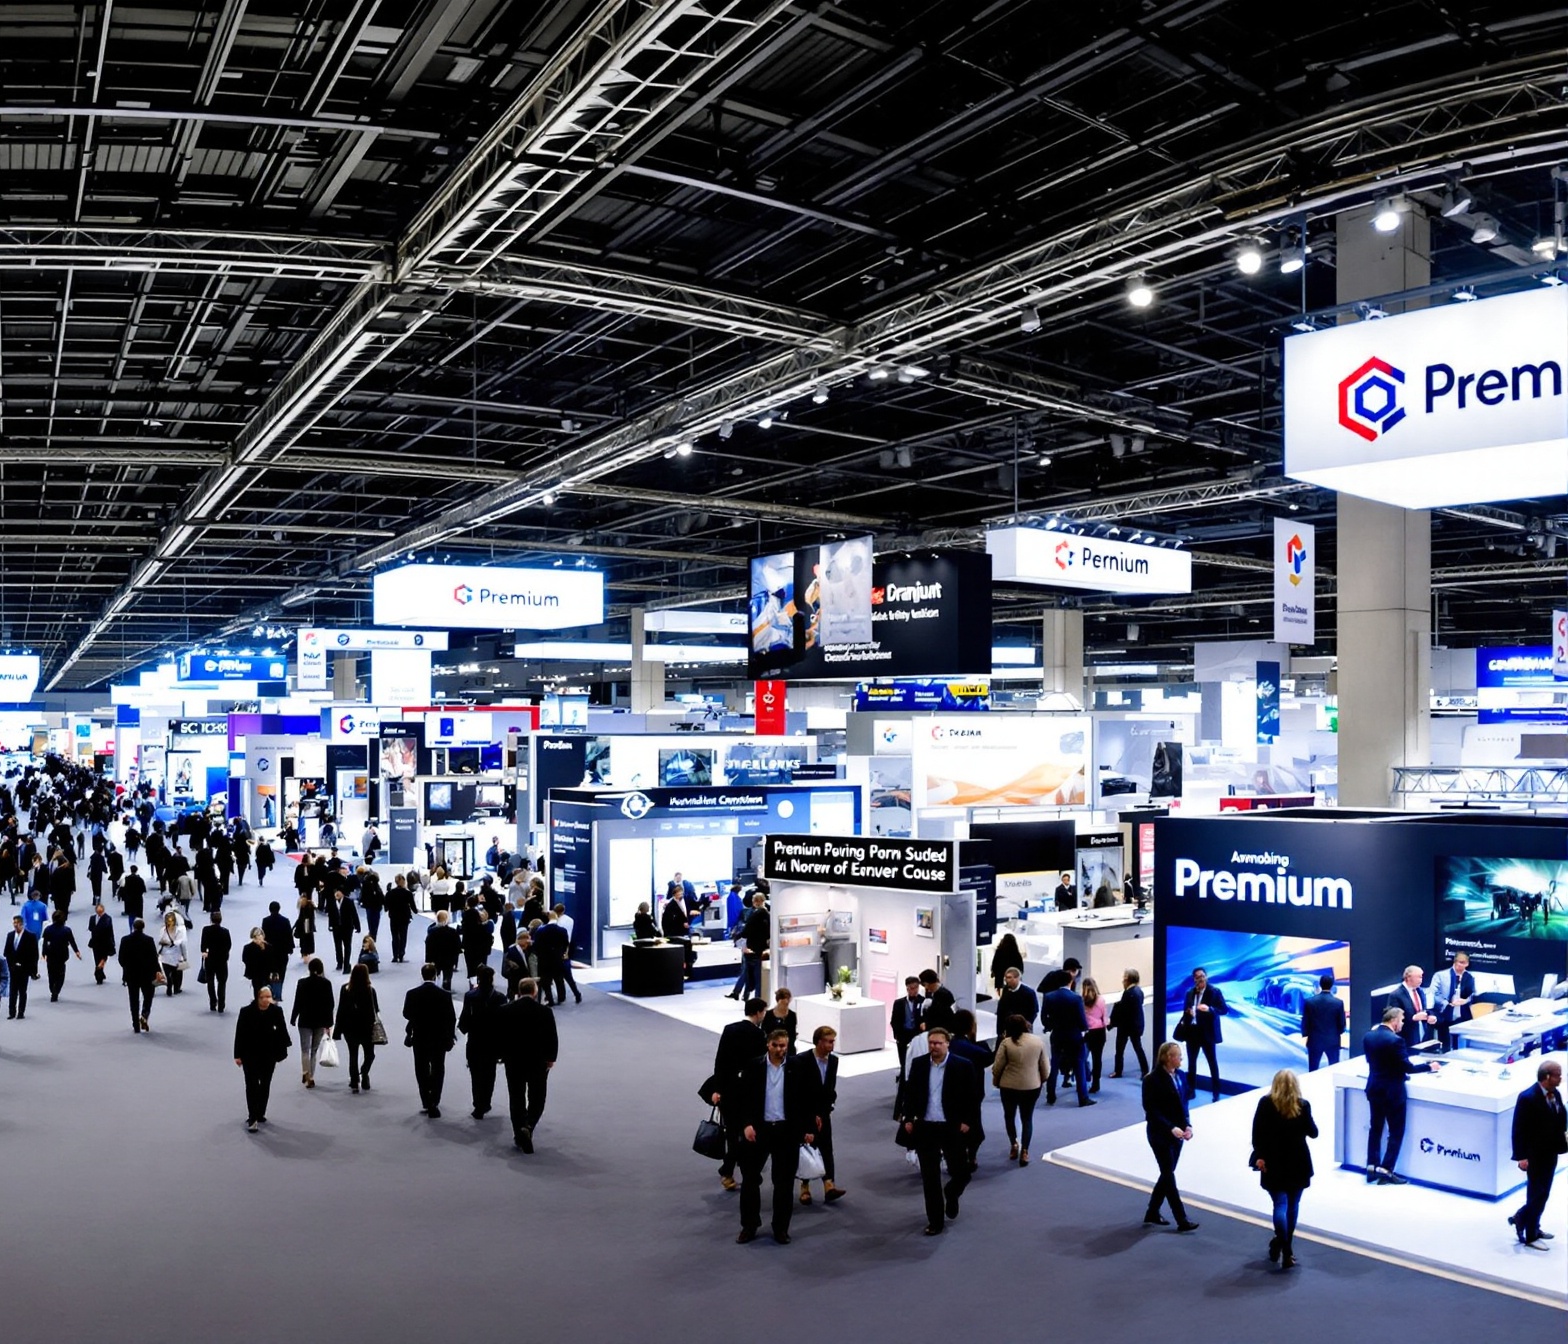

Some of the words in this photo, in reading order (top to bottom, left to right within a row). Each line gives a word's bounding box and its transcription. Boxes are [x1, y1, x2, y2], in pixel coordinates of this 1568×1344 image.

[1425, 360, 1562, 413] Prem
[1082, 546, 1150, 575] Pernium
[480, 588, 560, 607] Premium
[1174, 858, 1353, 910] Premium
